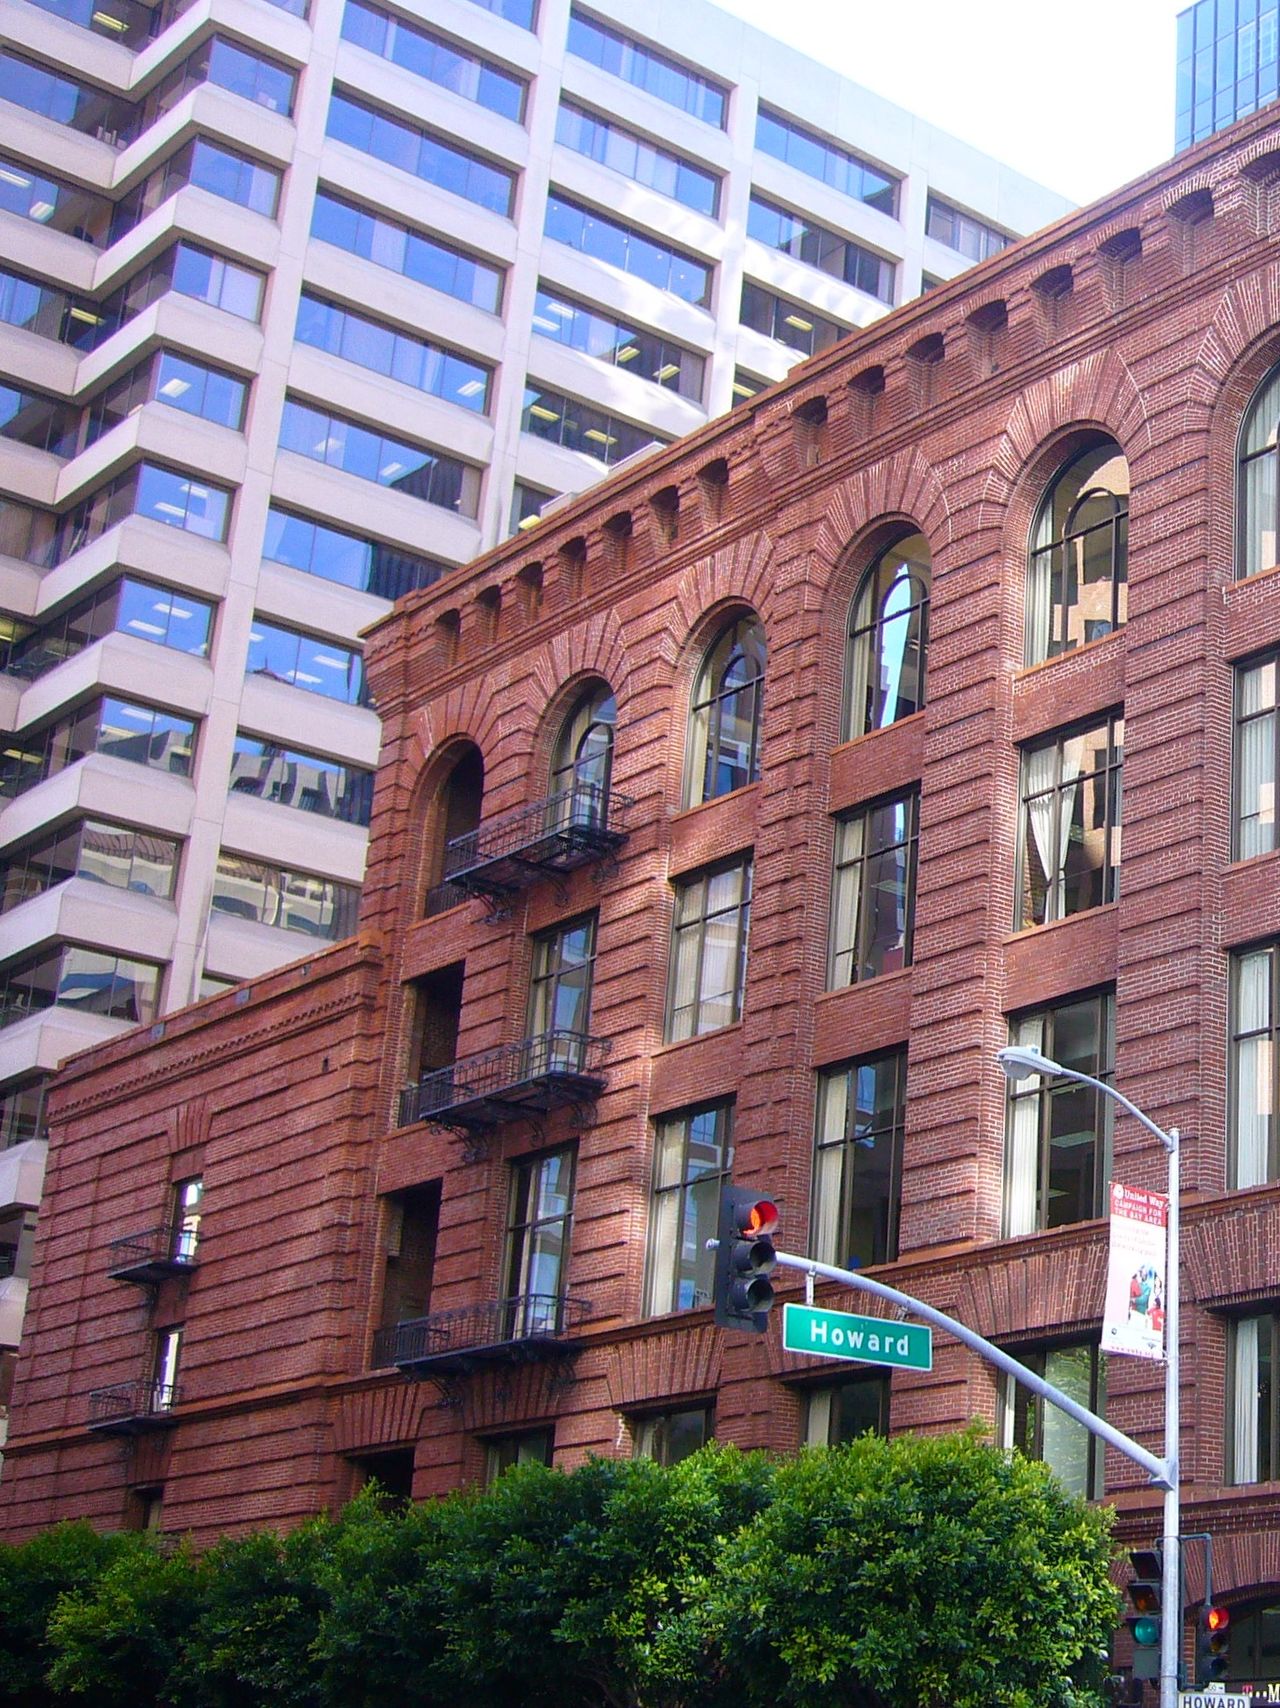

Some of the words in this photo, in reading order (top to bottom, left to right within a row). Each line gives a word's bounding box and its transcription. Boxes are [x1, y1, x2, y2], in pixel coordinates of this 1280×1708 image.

[1114, 1199, 1147, 1214] CAMPAIGN
[1149, 1207, 1162, 1218] FOR
[1124, 1189, 1147, 1204] United
[1149, 1195, 1164, 1209] Way
[1115, 1207, 1127, 1217] THE
[1129, 1210, 1142, 1220] BAY
[1143, 1215, 1162, 1225] AREA
[810, 1319, 909, 1356] Howard
[1183, 1696, 1246, 1708] HOWARD
